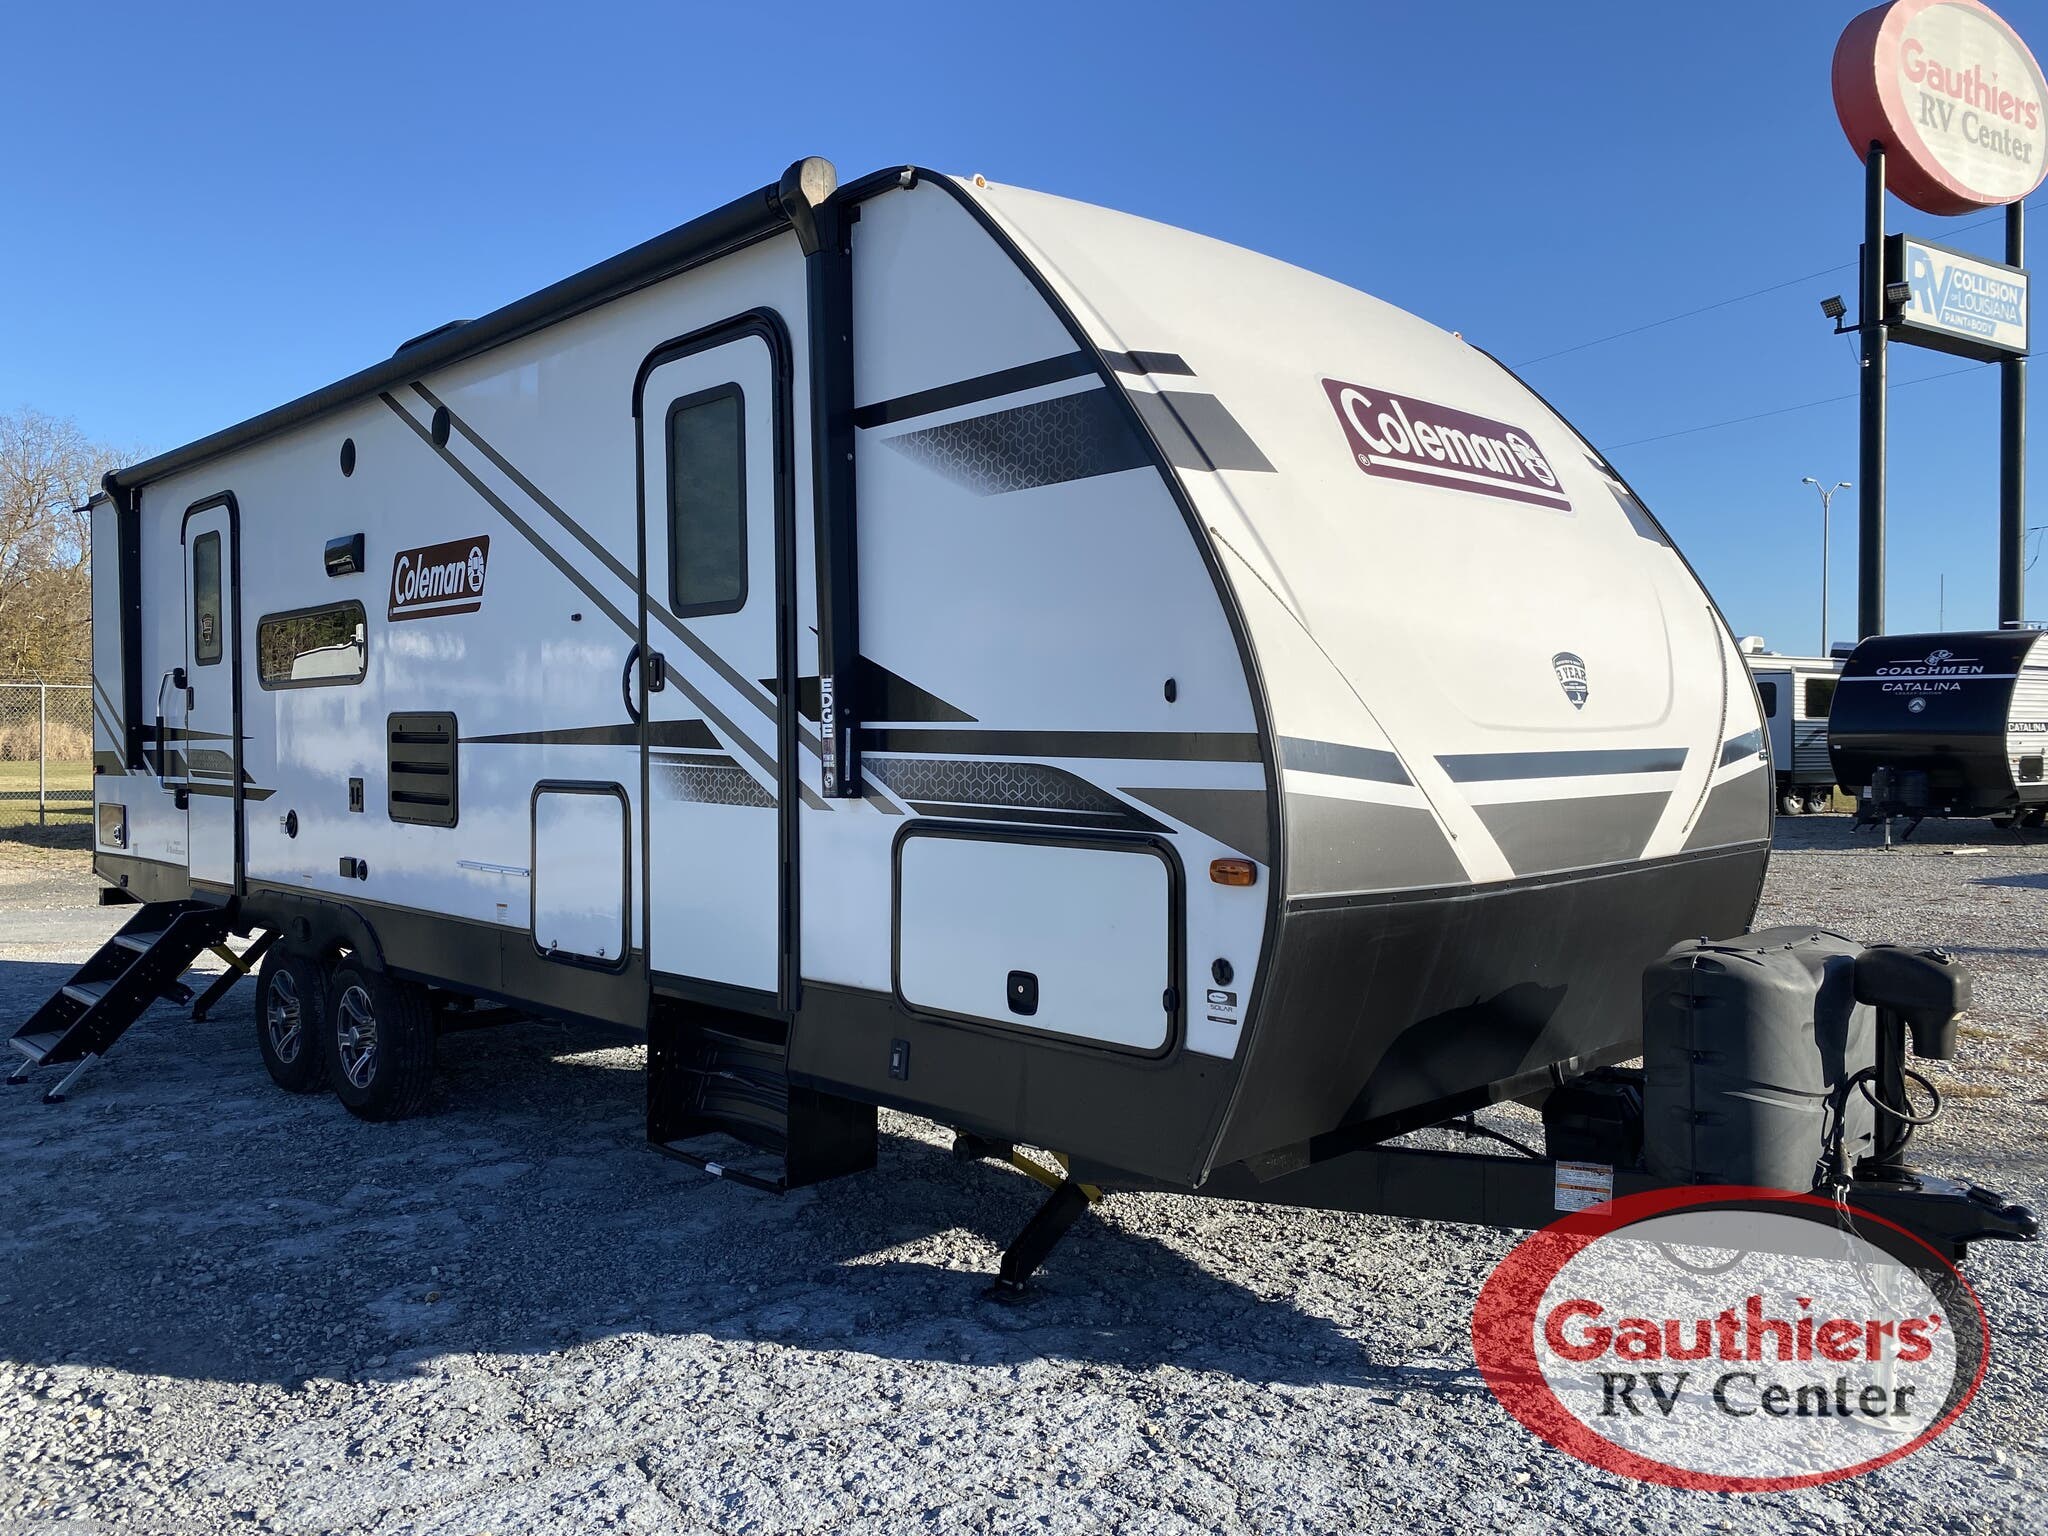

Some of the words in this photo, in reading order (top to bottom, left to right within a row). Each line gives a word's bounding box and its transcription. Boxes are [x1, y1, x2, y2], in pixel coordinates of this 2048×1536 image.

[1919, 91, 1955, 133] RV
[1962, 111, 2032, 164] Center
[1907, 245, 1954, 323] RV
[1953, 271, 2018, 305] COLLISION
[1958, 291, 2017, 321] LOUISIANA
[1340, 388, 1525, 478] Coleman
[394, 553, 466, 605] Coleman
[1562, 666, 1587, 681] YEAR
[1876, 665, 1984, 675] COACHMEN
[1882, 682, 1961, 691] CATALINA
[821, 678, 833, 738] EDGE
[2008, 723, 2046, 731] CATALINA
[1210, 1004, 1233, 1013] SOLAR
